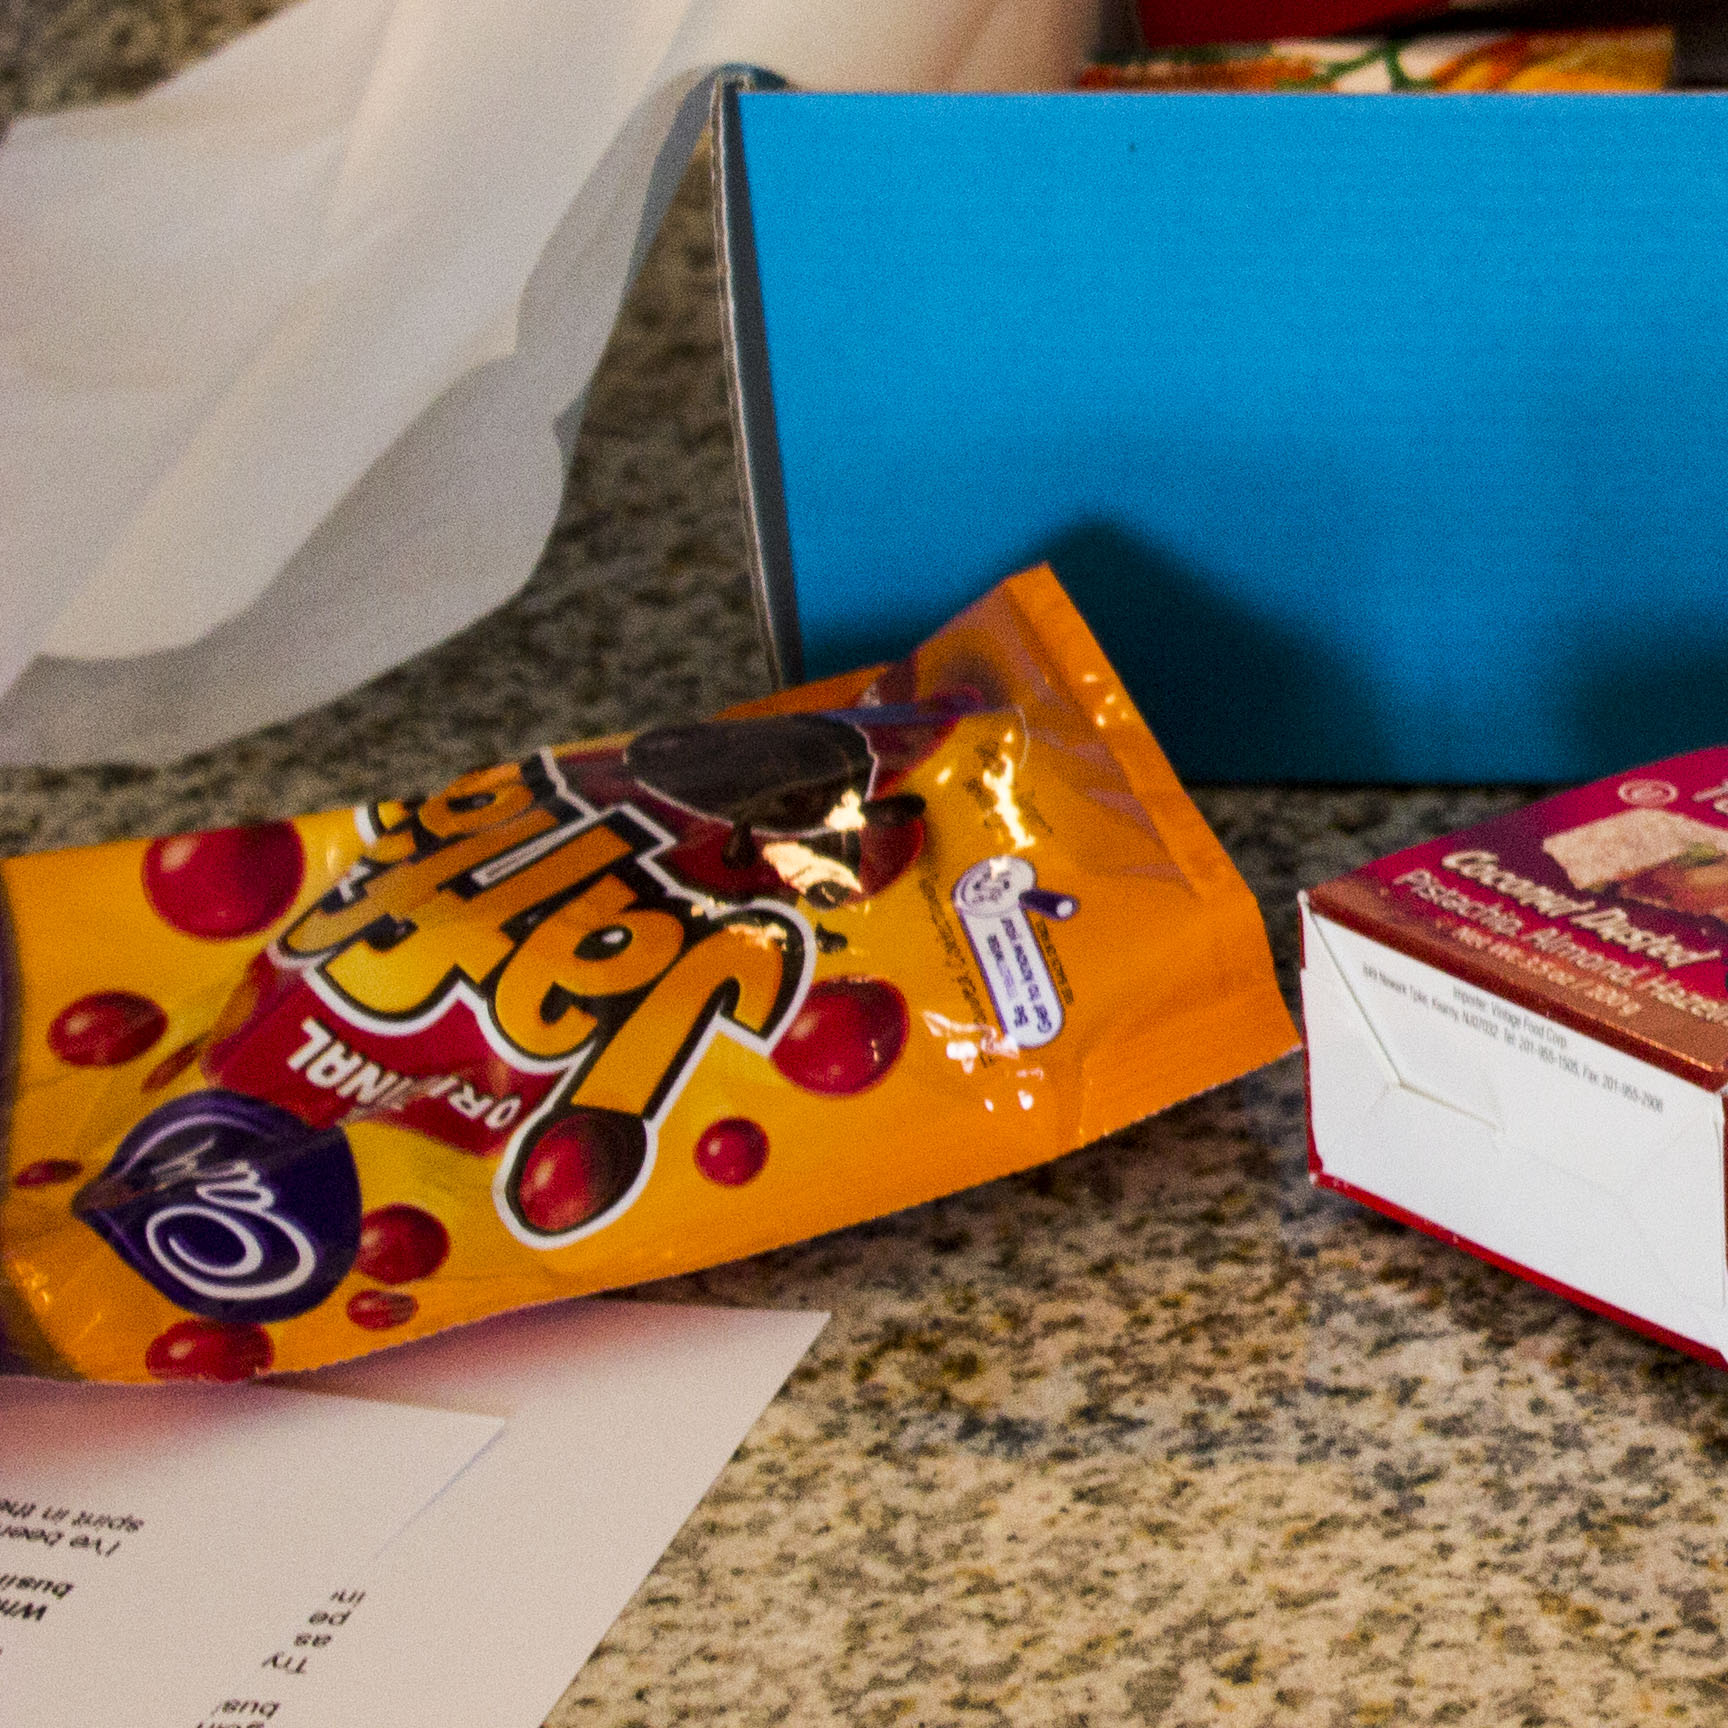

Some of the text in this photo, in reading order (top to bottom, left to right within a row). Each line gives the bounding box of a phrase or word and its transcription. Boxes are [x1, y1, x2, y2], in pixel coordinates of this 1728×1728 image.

[1441, 849, 1722, 969] Coconut Dusted
[1000, 918, 1053, 1034] Get to know your
[1490, 999, 1523, 1030] Vintage
[1522, 1015, 1545, 1038] Food
[284, 1015, 524, 1138] ORIINAL
[40, 1505, 70, 1524] in
[70, 1508, 146, 1534] spirit
[68, 1533, 122, 1559] I've
[292, 1631, 334, 1648] as
[260, 1650, 311, 1675] Try
